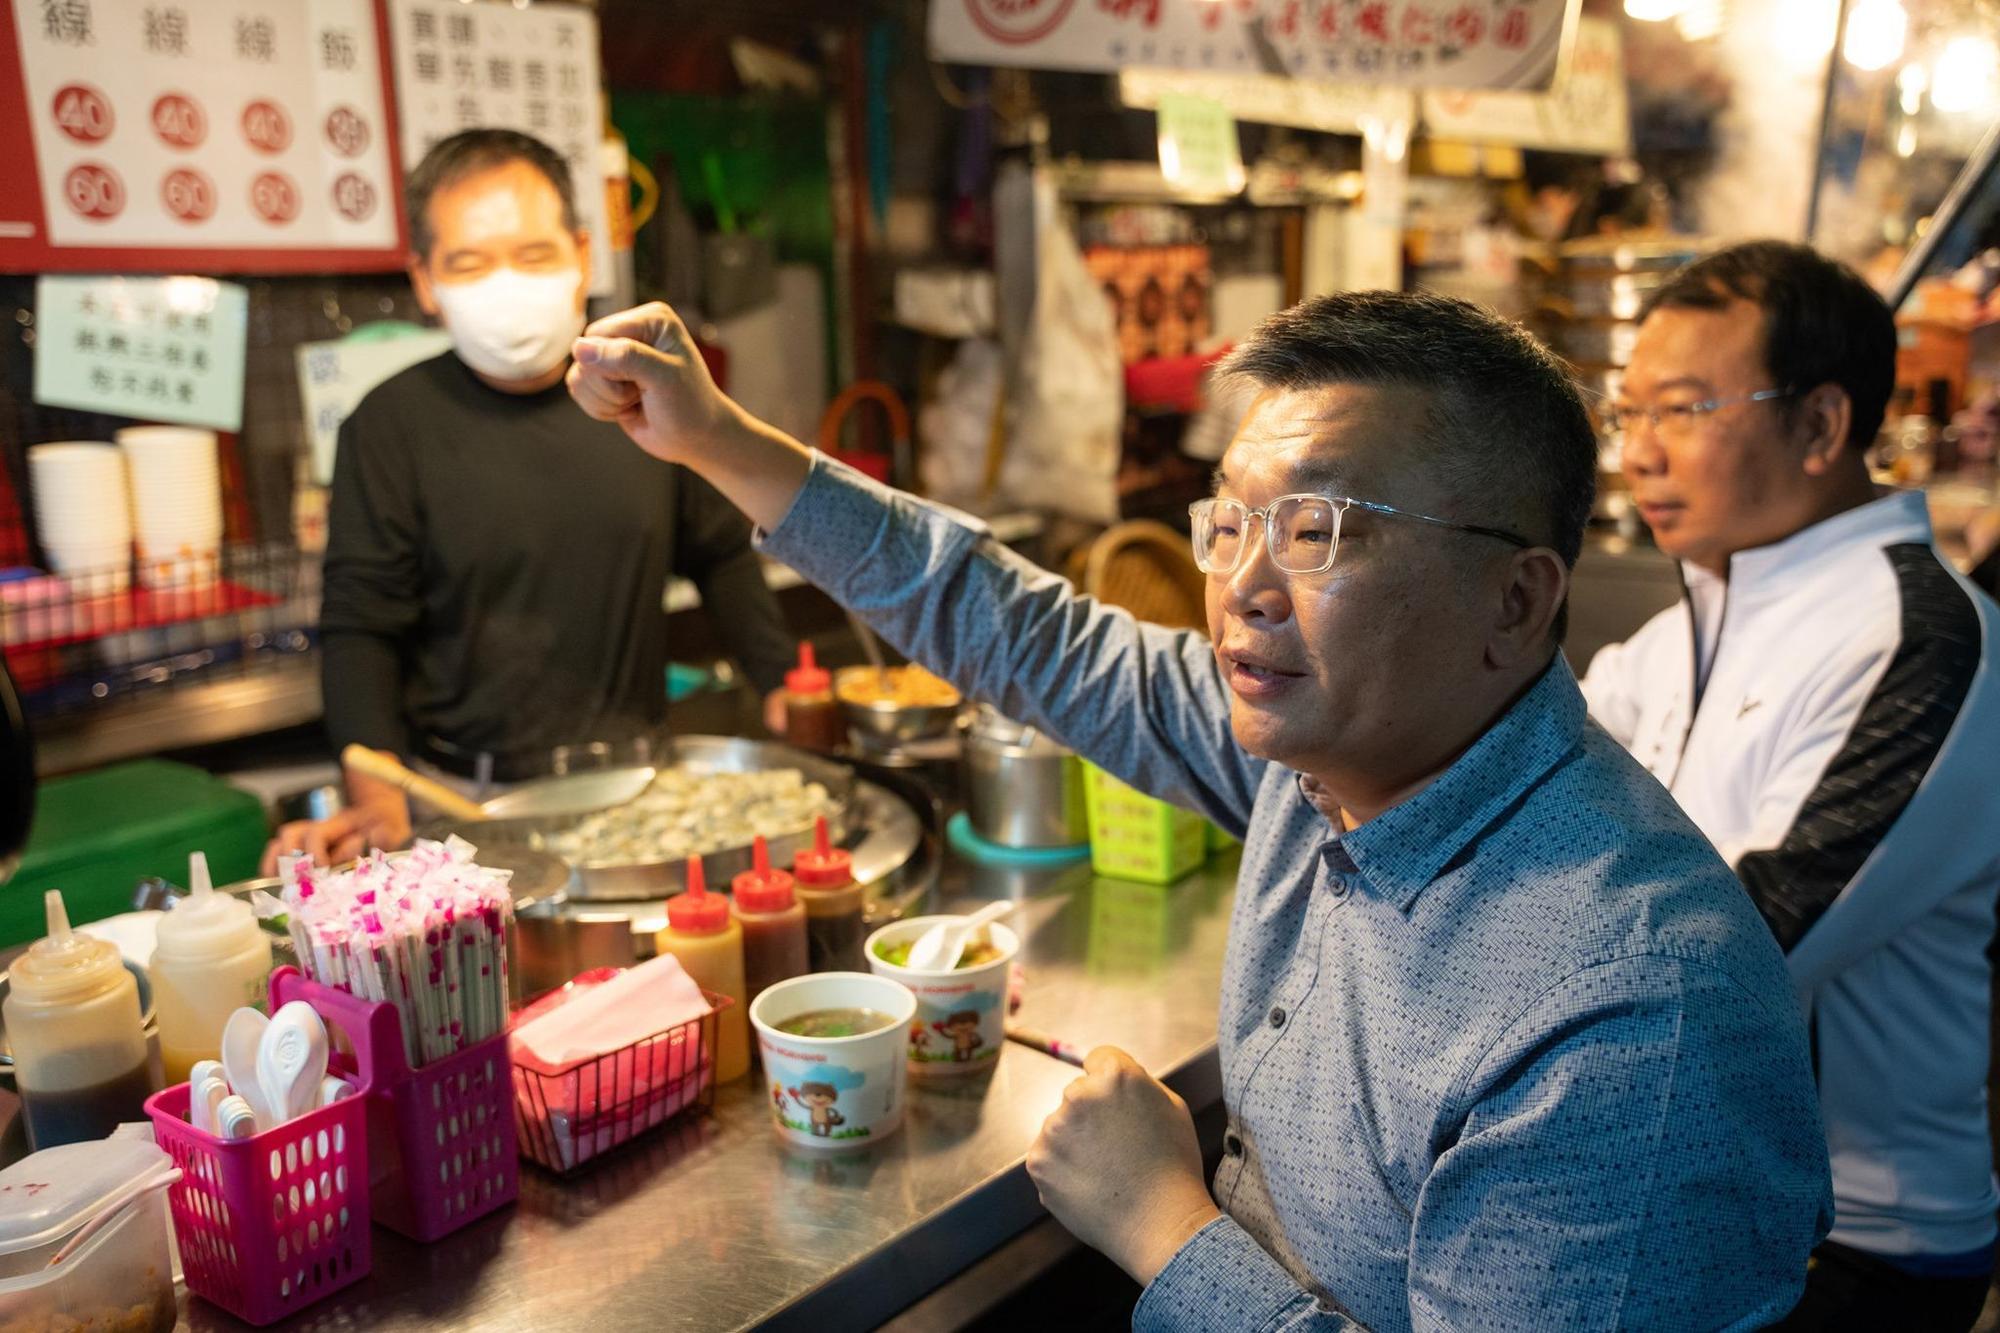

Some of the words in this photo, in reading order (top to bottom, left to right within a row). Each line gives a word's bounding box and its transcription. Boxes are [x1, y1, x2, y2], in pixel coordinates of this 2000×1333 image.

[57, 88, 113, 140] 40
[155, 98, 206, 146] 40
[244, 105, 292, 152] 40
[66, 168, 125, 220] 60
